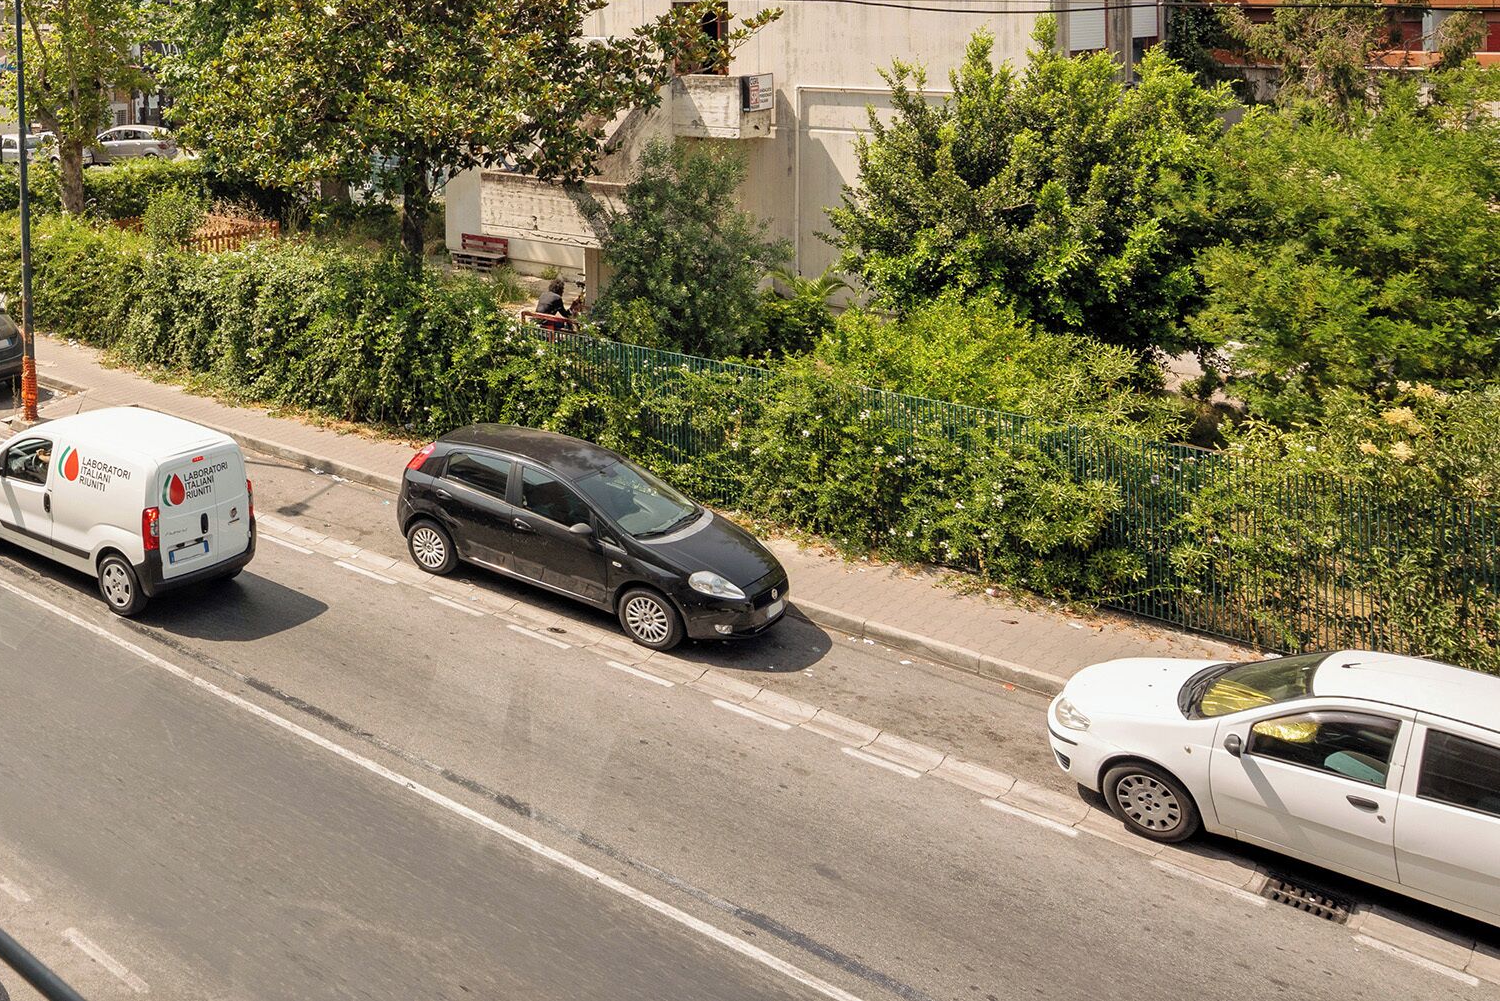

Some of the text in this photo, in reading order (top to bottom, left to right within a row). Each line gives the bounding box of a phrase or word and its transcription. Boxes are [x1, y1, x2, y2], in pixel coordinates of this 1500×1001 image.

[81, 466, 111, 484] ITALIANI
[82, 457, 131, 480] LABORATORI
[183, 461, 228, 482] LABORATORI
[79, 475, 106, 492] RIUNITI
[185, 475, 214, 490] ITALIANI
[186, 485, 212, 500] RIUNITI
